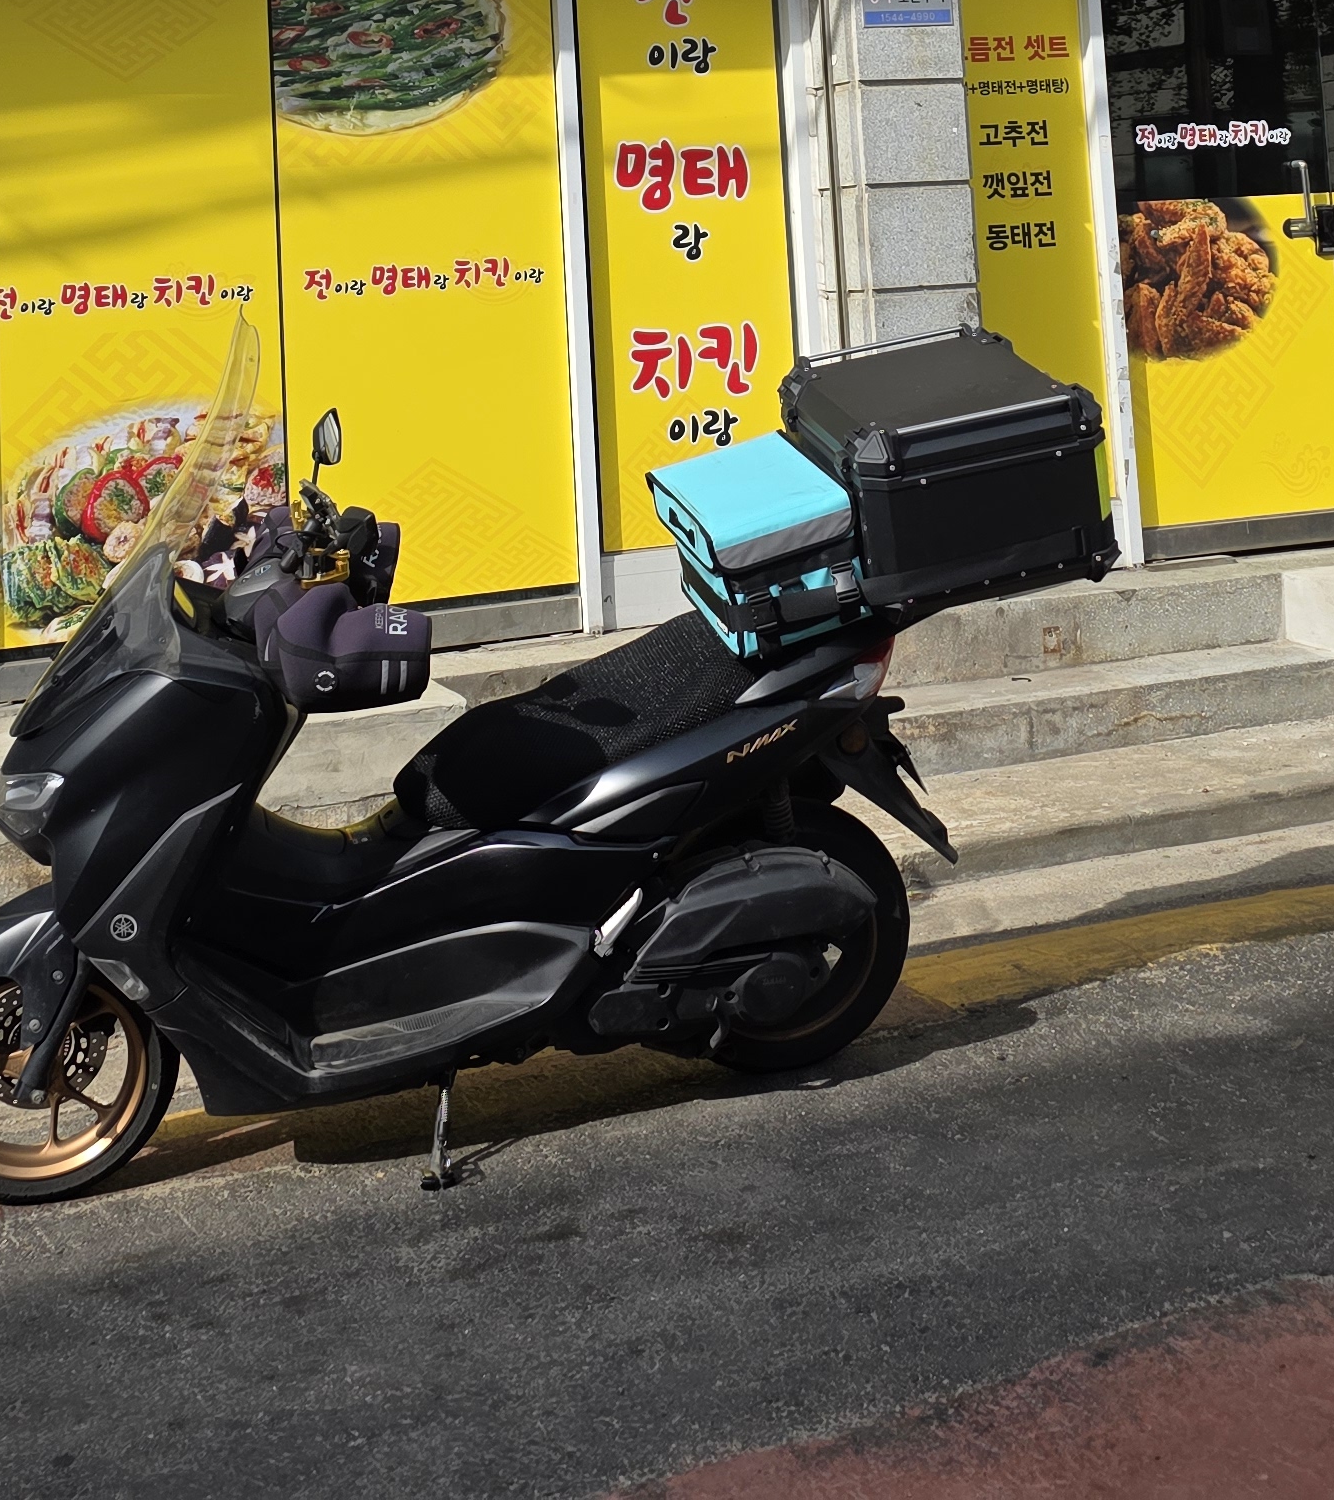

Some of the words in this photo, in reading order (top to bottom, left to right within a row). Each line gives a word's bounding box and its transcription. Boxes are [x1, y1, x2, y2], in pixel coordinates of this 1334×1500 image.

[880, 12, 935, 22] 1544-4990
[647, 36, 717, 75] 이랑
[964, 36, 1015, 63] 듬전
[1024, 34, 1069, 62] 셋트
[966, 77, 1070, 97] +명태전+명태탕)
[979, 120, 1049, 147] 고추전
[614, 139, 750, 213] 명태
[983, 170, 1053, 199] 깻잎전
[671, 222, 709, 262] 랑
[986, 221, 1057, 251] 동태전
[61, 282, 148, 318] 명태랑
[152, 273, 254, 308] 치킨이랑
[303, 268, 367, 302] 전이랑
[371, 263, 449, 296] 명태랑
[453, 256, 545, 289] 치킨이랑
[629, 320, 760, 400] 치킨
[668, 408, 739, 447] 이랑
[727, 719, 798, 764] NMAX
